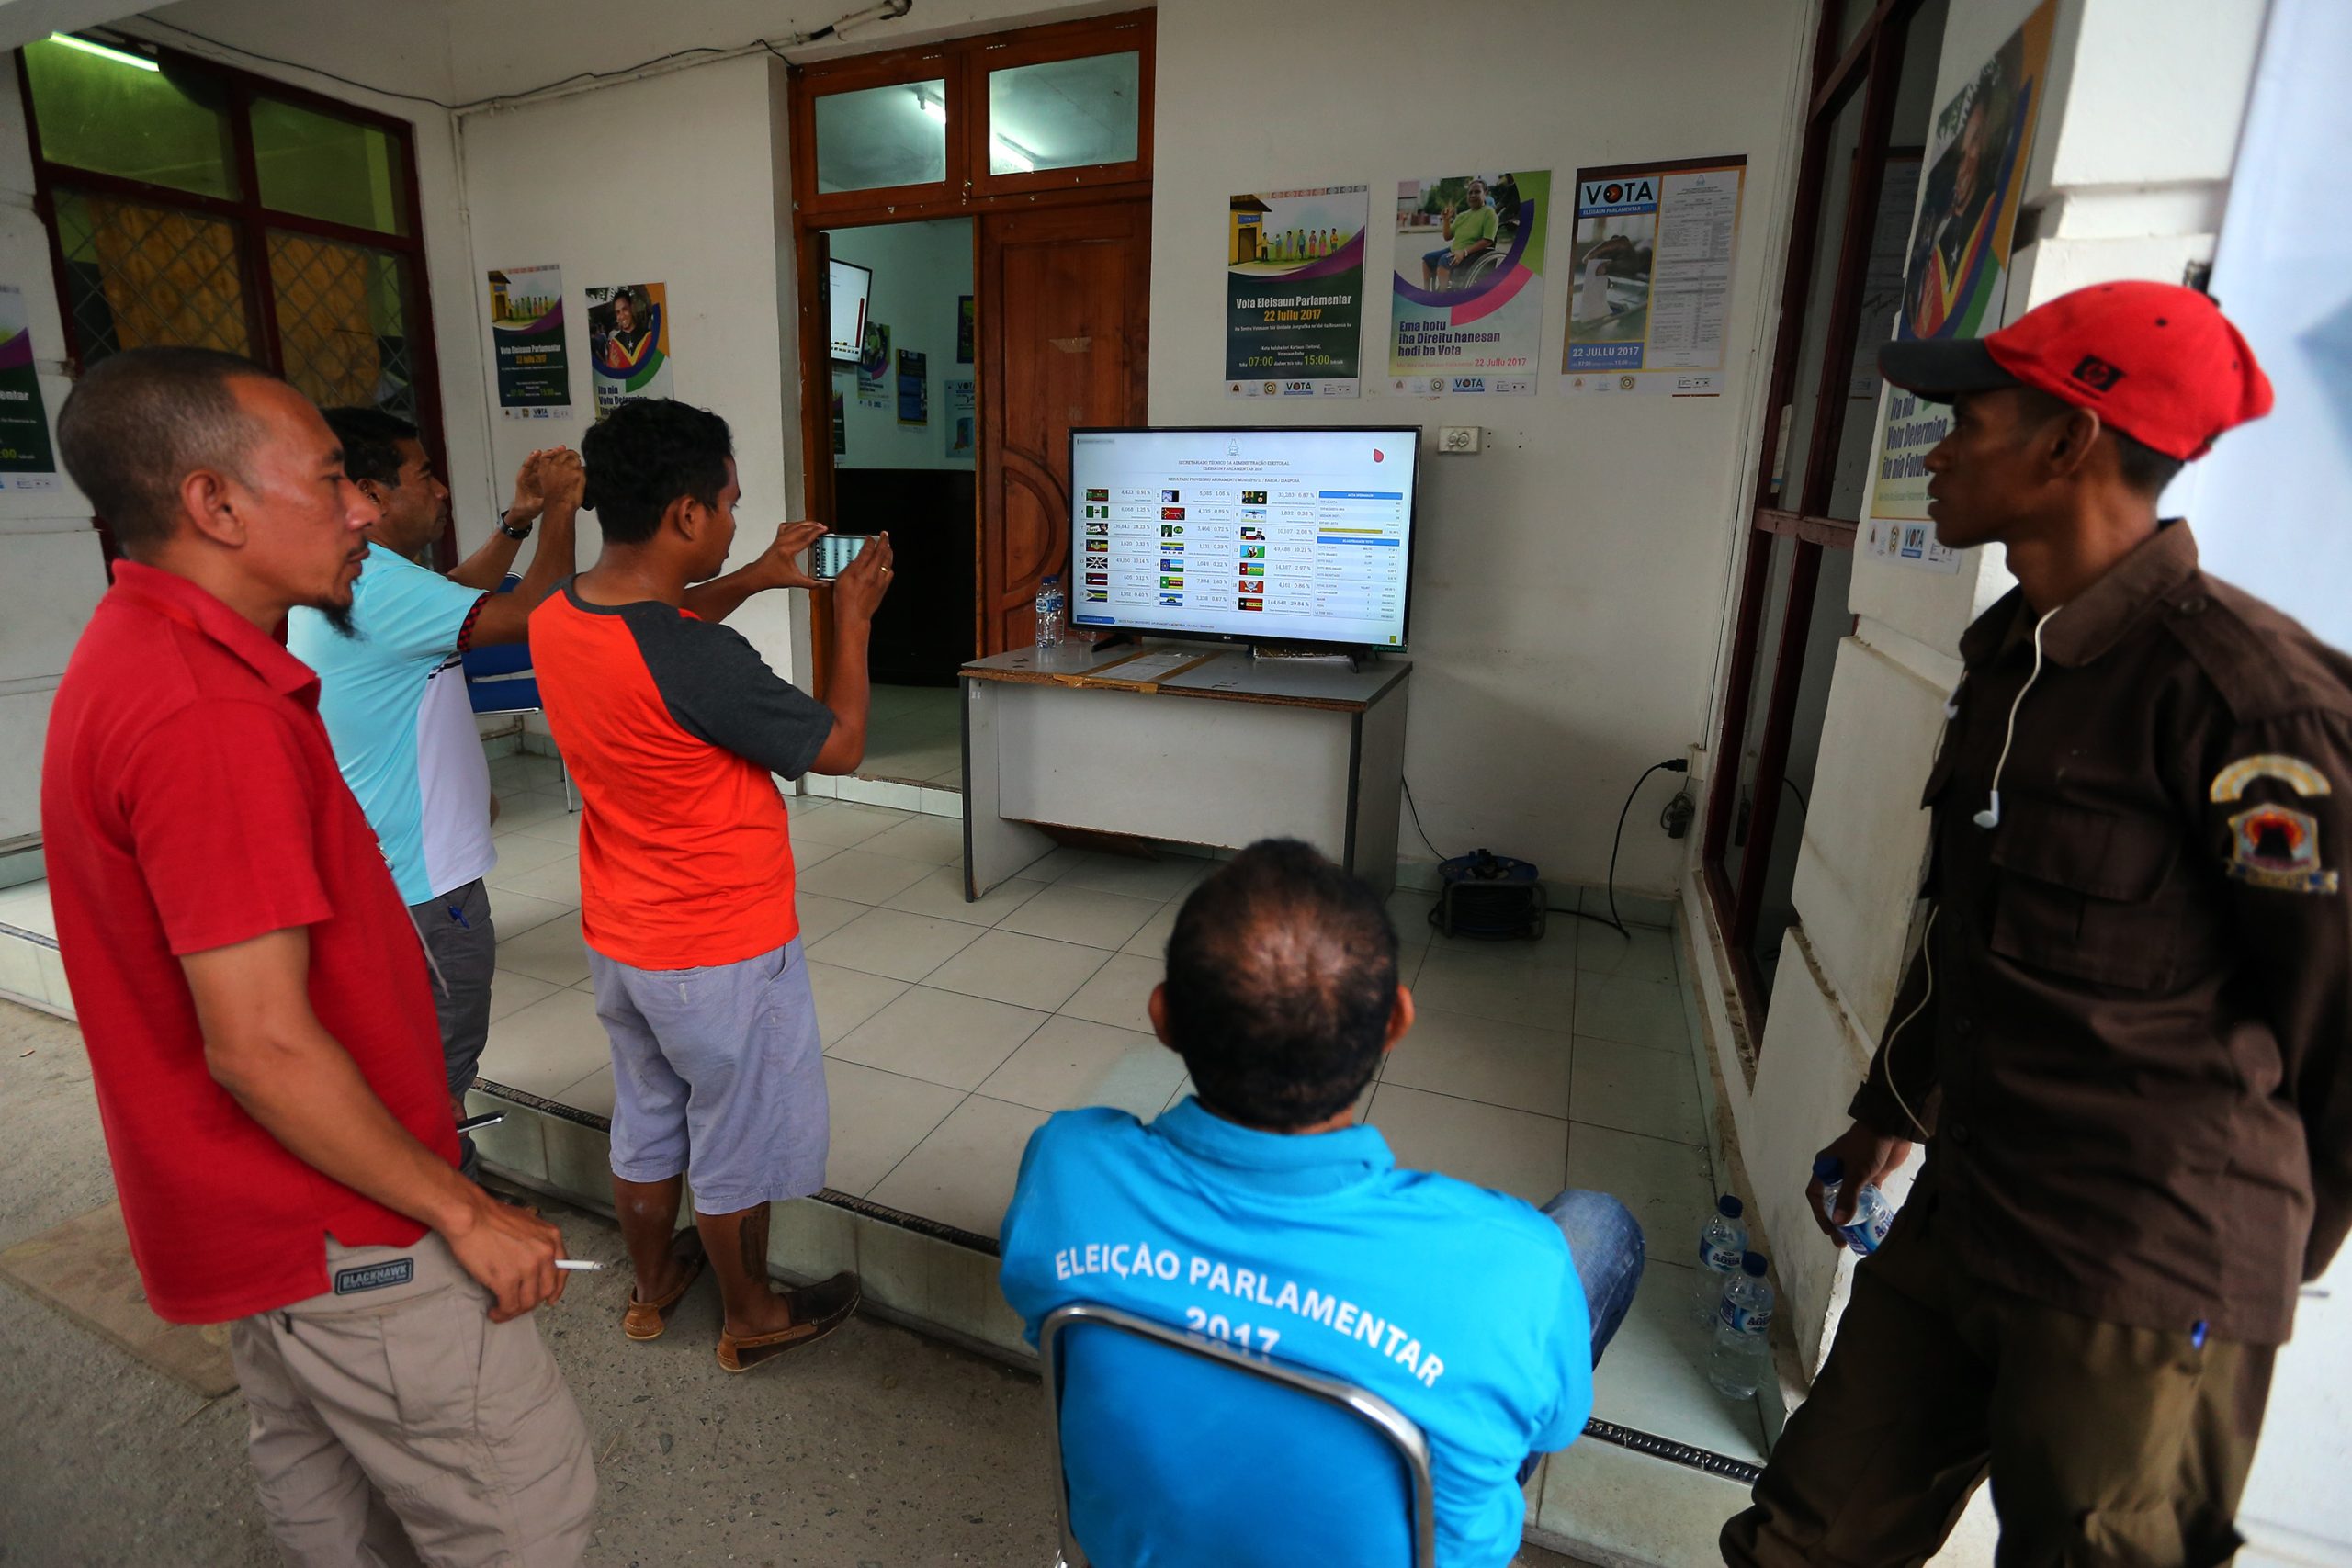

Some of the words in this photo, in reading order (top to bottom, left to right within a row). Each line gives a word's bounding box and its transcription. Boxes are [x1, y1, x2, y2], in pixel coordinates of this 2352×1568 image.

[1586, 181, 1653, 205] VOTA
[1236, 299, 1255, 309] Vota
[1257, 297, 1294, 308] Eleisaun
[1295, 295, 1351, 306] Parlamentar
[1264, 310, 1275, 321] 22
[1300, 309, 1321, 320] 2017
[1399, 321, 1420, 332] Ema
[1423, 321, 1446, 332] hotu
[1398, 333, 1415, 344] iha
[1418, 333, 1452, 344] Direitu
[1454, 332, 1500, 344] hanesan
[1398, 345, 1420, 356] hodi
[1423, 346, 1435, 356] ba
[1438, 345, 1462, 355] Vota
[1572, 348, 1584, 357] 22
[1586, 347, 1615, 357] JULLU
[1617, 346, 1640, 356] 2017
[1249, 356, 1273, 367] 07:00
[1305, 355, 1329, 366] 15:00
[1475, 358, 1484, 367] 22
[1487, 358, 1505, 367] Jullu
[1507, 357, 1526, 366] 2017
[1286, 382, 1312, 390] VOTA
[1455, 378, 1483, 388] VOTA
[1886, 426, 1905, 450] Votu
[1904, 415, 1947, 447] Determina
[1905, 528, 1925, 549] VOTA
[343, 1264, 407, 1289] BLACKHAWK
[1055, 1241, 1181, 1281] ELEIÇÃO
[1189, 1256, 1444, 1388] PARLAMENTAR
[1186, 1305, 1281, 1355] 2017
